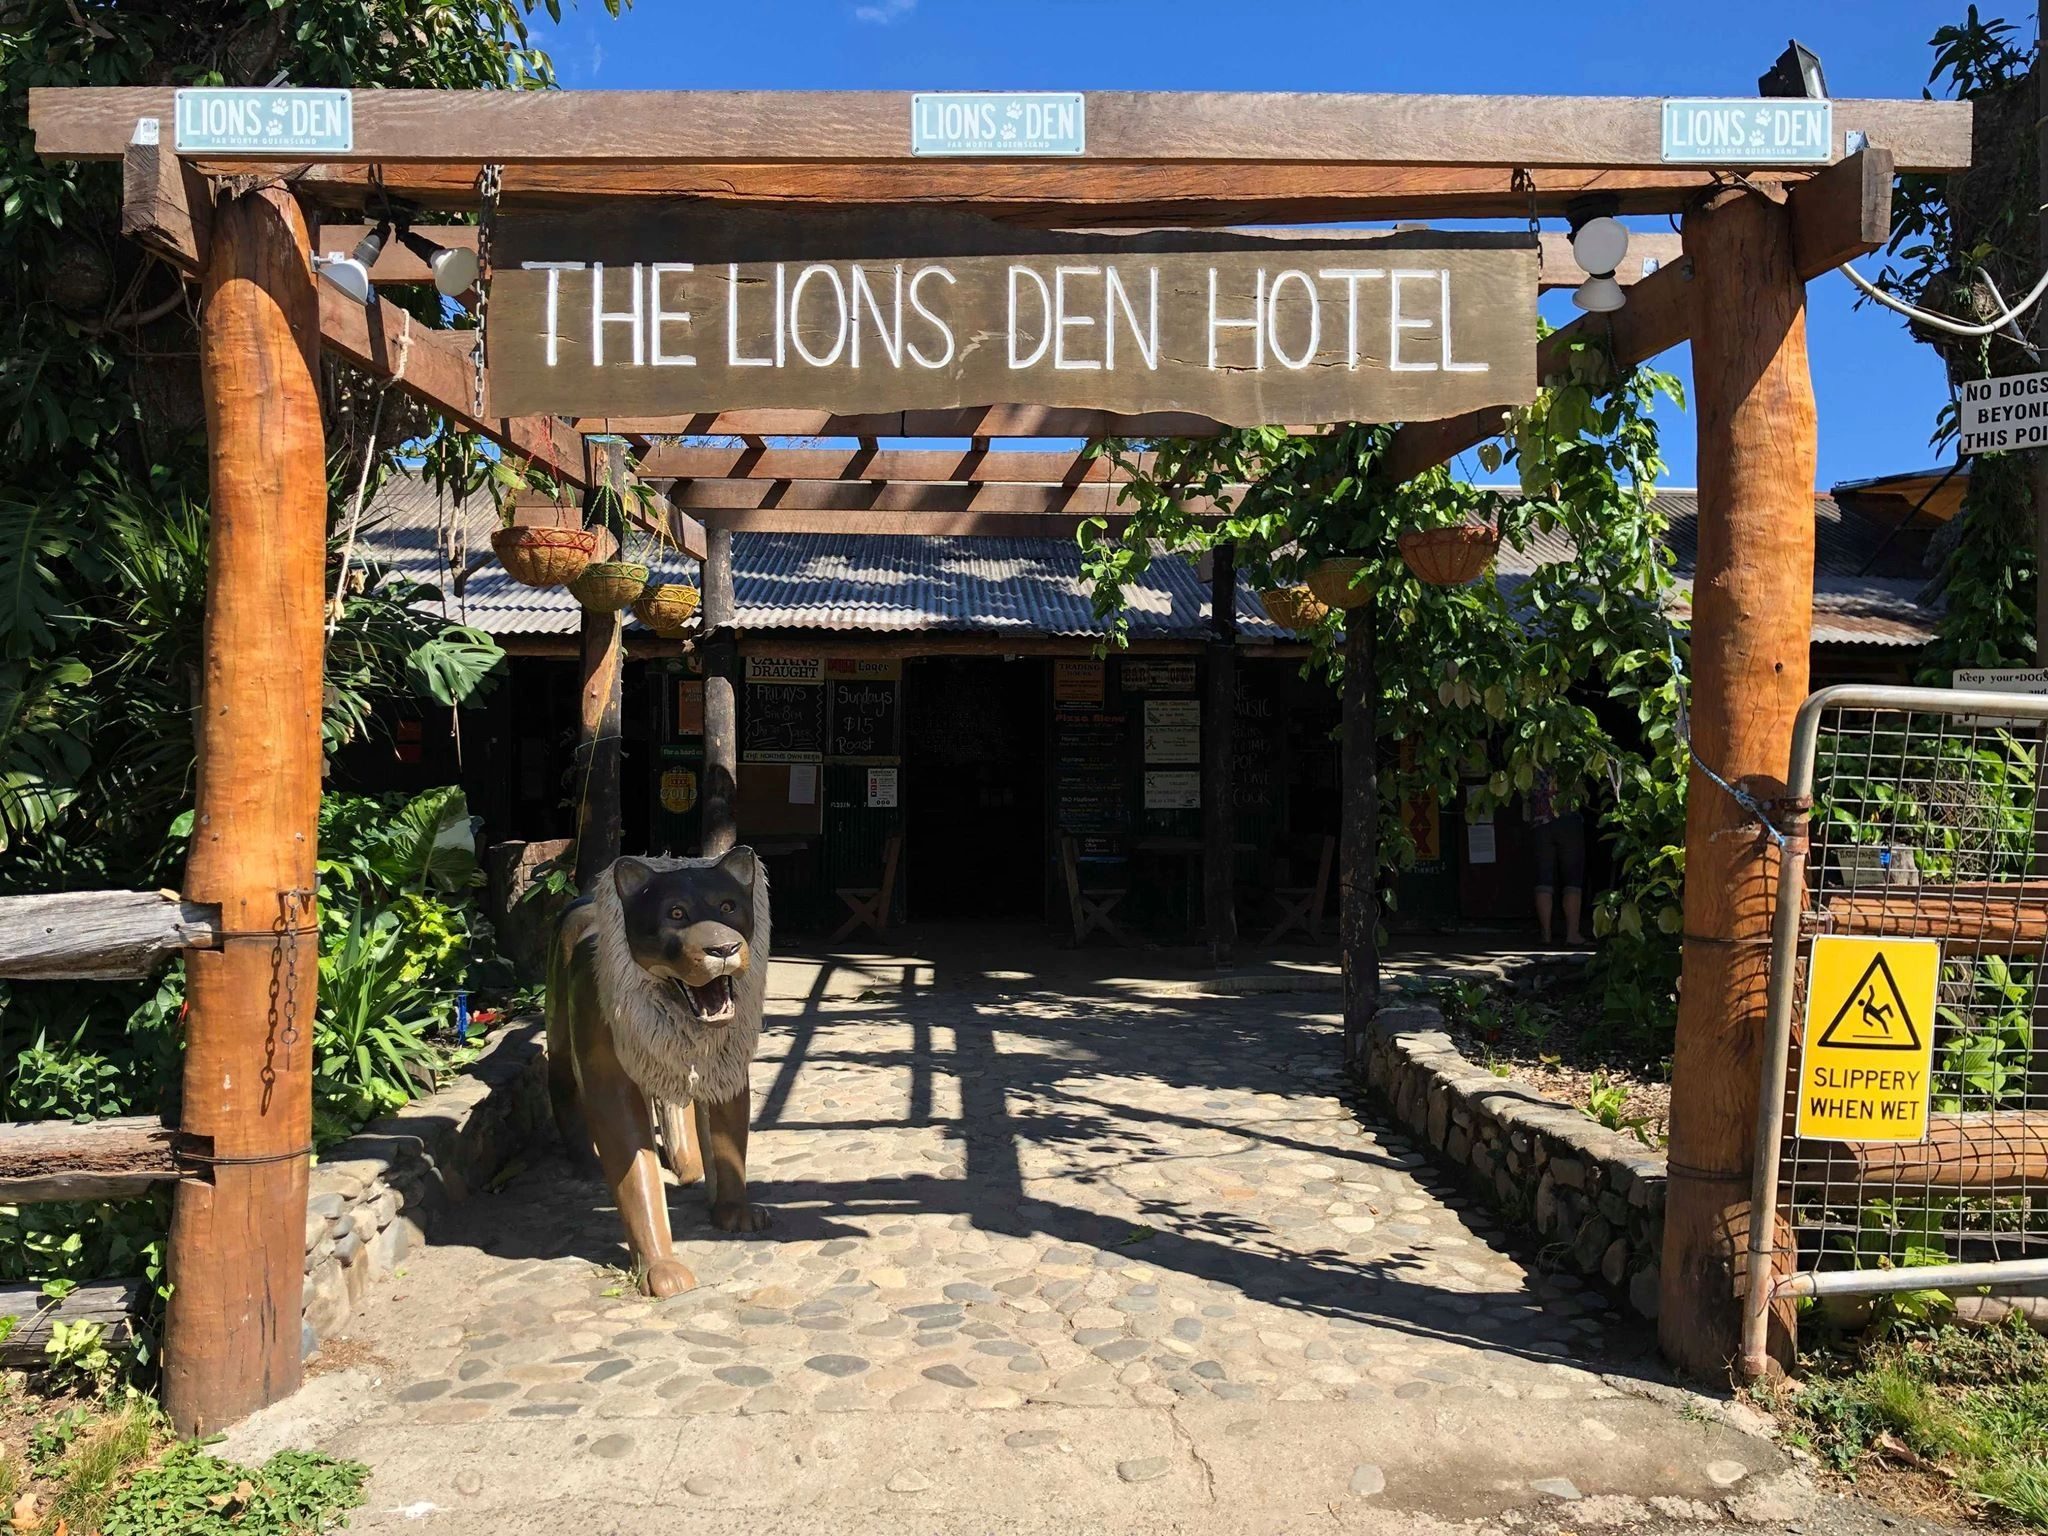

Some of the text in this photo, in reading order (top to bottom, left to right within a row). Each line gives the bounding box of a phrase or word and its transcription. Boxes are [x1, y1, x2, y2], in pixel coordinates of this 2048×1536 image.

[185, 98, 343, 137] LIONS DEN
[921, 102, 1075, 140] LIONS DEN
[1672, 108, 1822, 147] LIONS DEN
[262, 137, 317, 145] QUEENSLAND
[1696, 147, 1797, 155] FAR NORTH QUEENSLAND
[521, 261, 1490, 372] THE LIONS DEN HOTEL
[1966, 376, 2048, 402] NO DOGS
[1965, 429, 2008, 449] THIS
[752, 666, 818, 678] DRAUGHT
[1060, 663, 1099, 671] TRADING
[1959, 672, 1985, 684] Keep
[1990, 674, 2014, 684] your
[837, 685, 894, 718] Sundays
[842, 716, 874, 735] $15
[835, 736, 876, 755] Roast
[787, 752, 802, 760] OWN
[1814, 1067, 1921, 1091] SLIPPERY
[1810, 1097, 1920, 1121] WHEN WET
